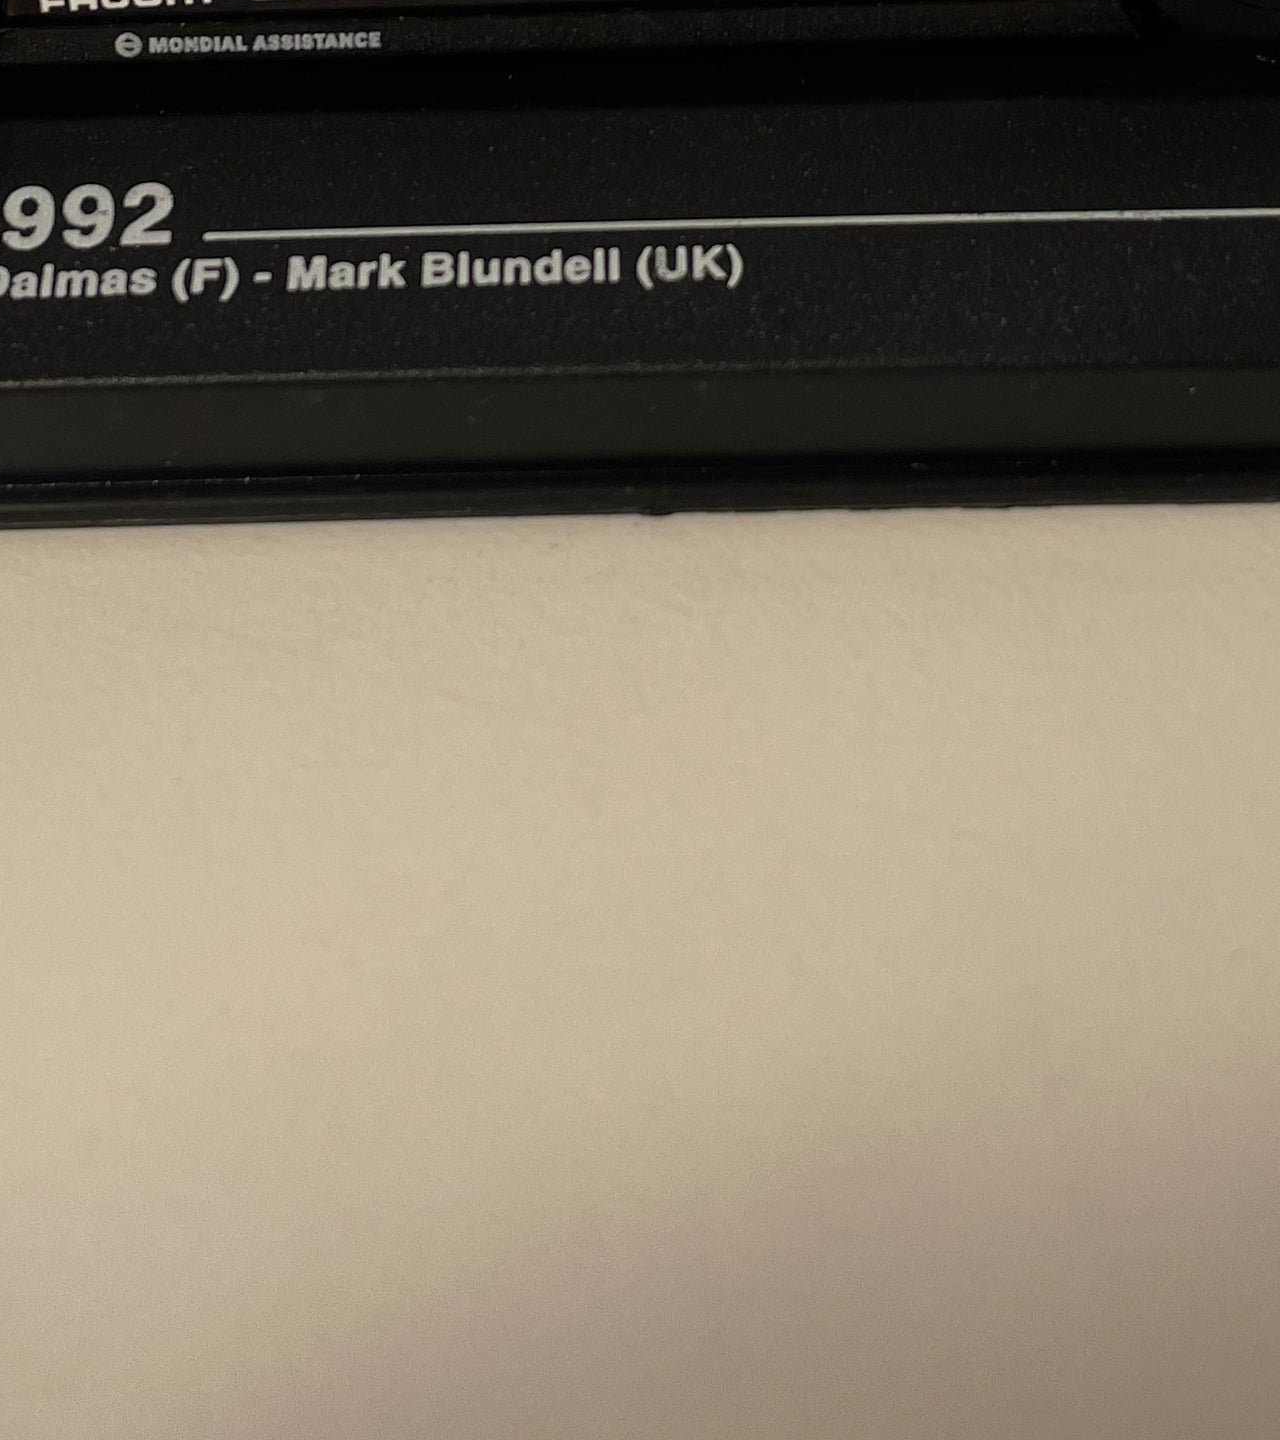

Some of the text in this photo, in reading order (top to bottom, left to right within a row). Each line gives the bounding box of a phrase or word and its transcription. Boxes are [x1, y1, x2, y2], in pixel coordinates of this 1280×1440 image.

[148, 31, 382, 54] MONDIAL ASSISTANCE
[172, 258, 240, 303] (F)
[253, 271, 272, 283] -
[286, 253, 406, 291] Mark
[421, 247, 621, 287] Blundell
[636, 243, 743, 289] (UK)
